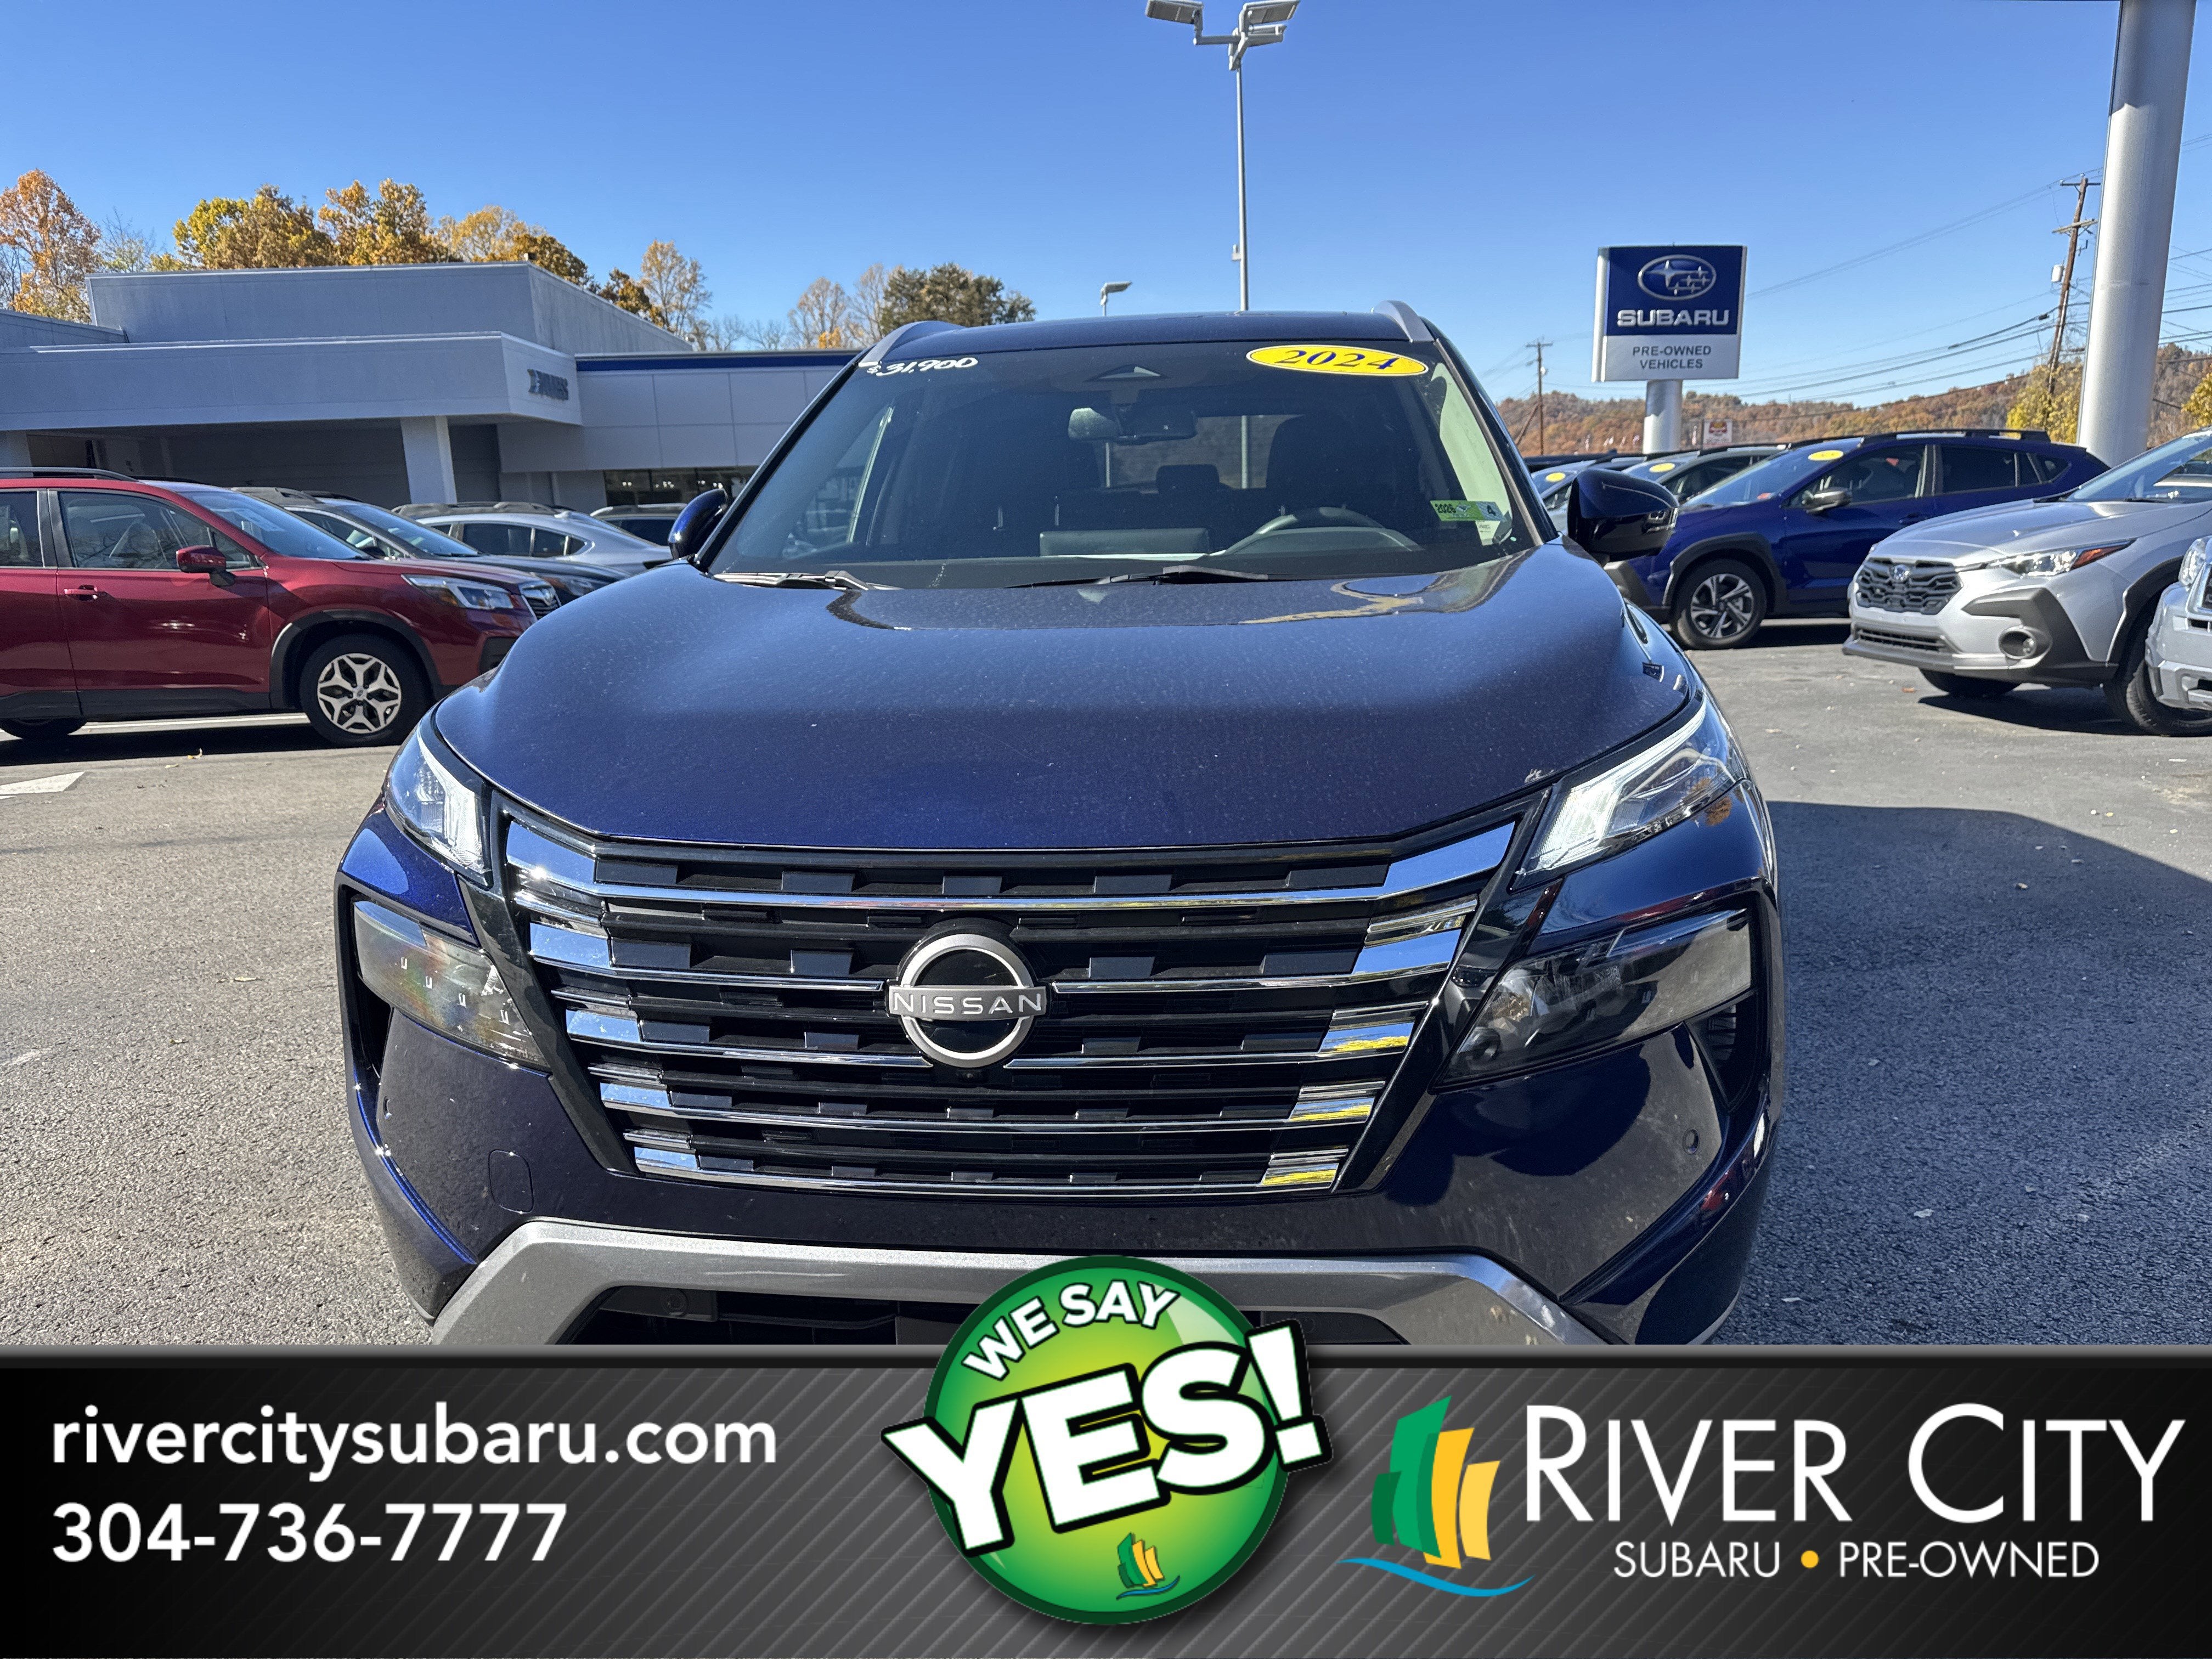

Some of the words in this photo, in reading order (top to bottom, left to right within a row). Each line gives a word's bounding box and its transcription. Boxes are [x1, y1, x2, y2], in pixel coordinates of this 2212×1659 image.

[1617, 309, 1729, 326] SUBARU
[1274, 349, 1401, 370] 2024
[1632, 345, 1712, 357] PRE-OWNED
[1639, 359, 1703, 370] VEHICLES
[893, 992, 1042, 1015] NISSAN
